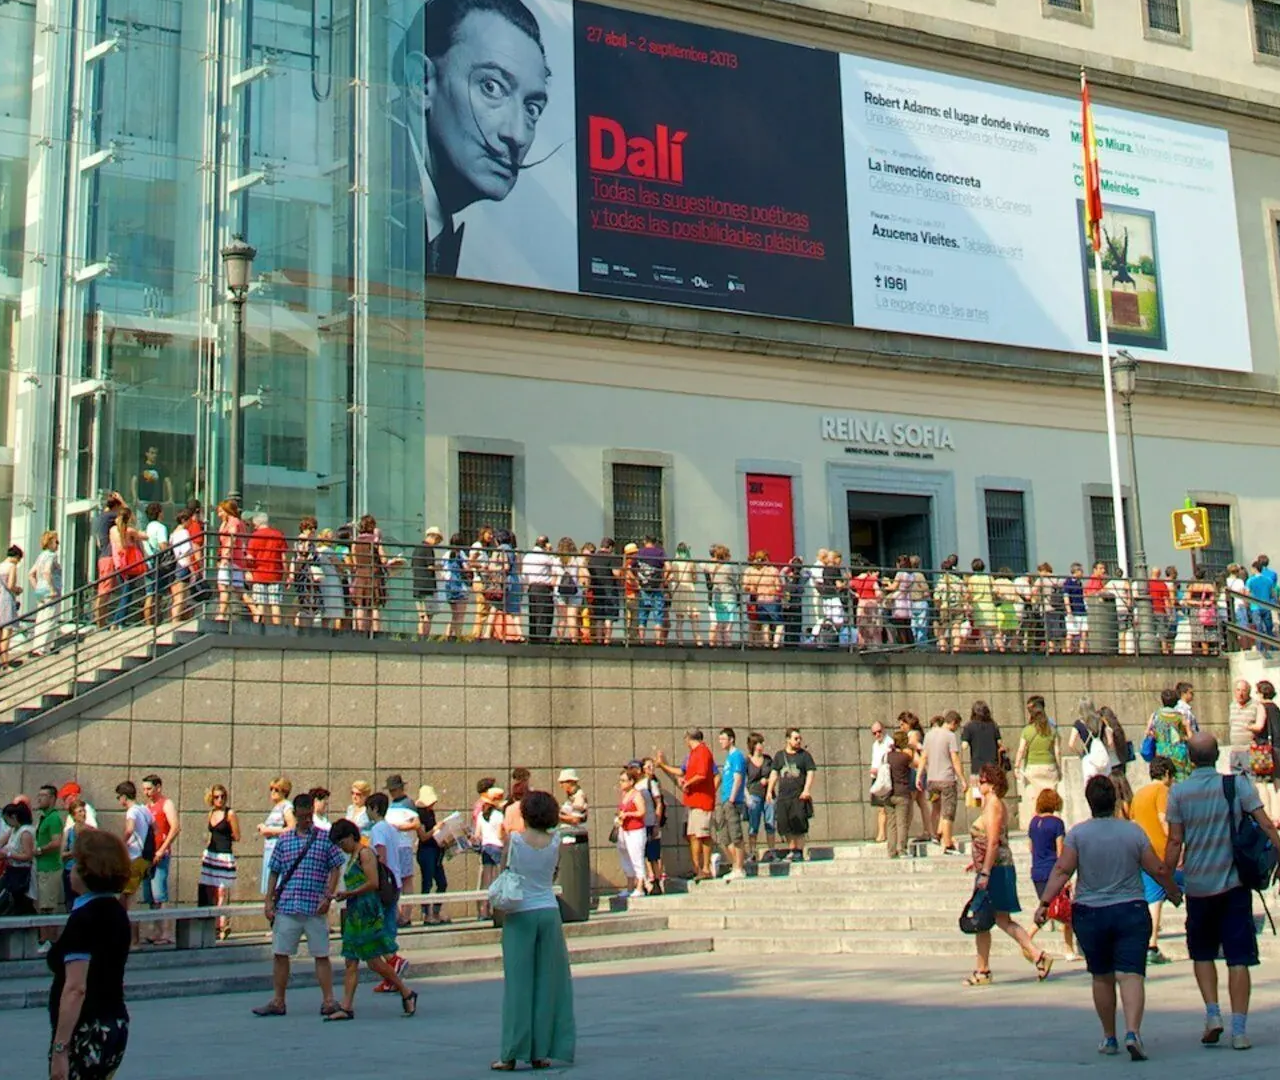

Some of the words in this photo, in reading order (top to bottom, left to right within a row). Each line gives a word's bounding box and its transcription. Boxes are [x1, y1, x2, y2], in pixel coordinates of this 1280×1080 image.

[586, 26, 602, 42] 27
[605, 31, 627, 48] abril
[638, 36, 646, 51] 2
[649, 40, 708, 63] septiembre
[709, 50, 738, 69] 2013
[864, 91, 901, 110] Robert
[903, 99, 941, 118] Adams:
[943, 107, 953, 120] el
[954, 108, 979, 126] lugar
[981, 114, 1012, 131] donde
[1013, 121, 1050, 138] vivimos
[588, 115, 688, 183] Dalí
[1105, 137, 1134, 153] Miura.
[868, 157, 881, 171] La
[883, 160, 934, 180] invención
[936, 172, 981, 188] concreta
[1100, 179, 1140, 196] Meireles
[590, 176, 636, 203] Todas
[639, 184, 660, 205] las
[663, 191, 748, 218] sugestiones
[751, 205, 810, 228] poéticas
[869, 175, 914, 194] Colección
[915, 182, 950, 201] Patricia
[983, 194, 994, 208] de
[590, 209, 599, 228] y
[604, 208, 645, 230] todas
[649, 211, 669, 233] las
[672, 217, 762, 248] posibilidades
[765, 232, 825, 257] plásticas
[872, 223, 918, 242] Azucena
[920, 231, 960, 249] Vieites.
[884, 275, 907, 291] 1961
[876, 294, 889, 308] La
[938, 303, 950, 316] de
[951, 303, 966, 318] las
[967, 306, 989, 320] artes
[821, 416, 890, 445] REINA
